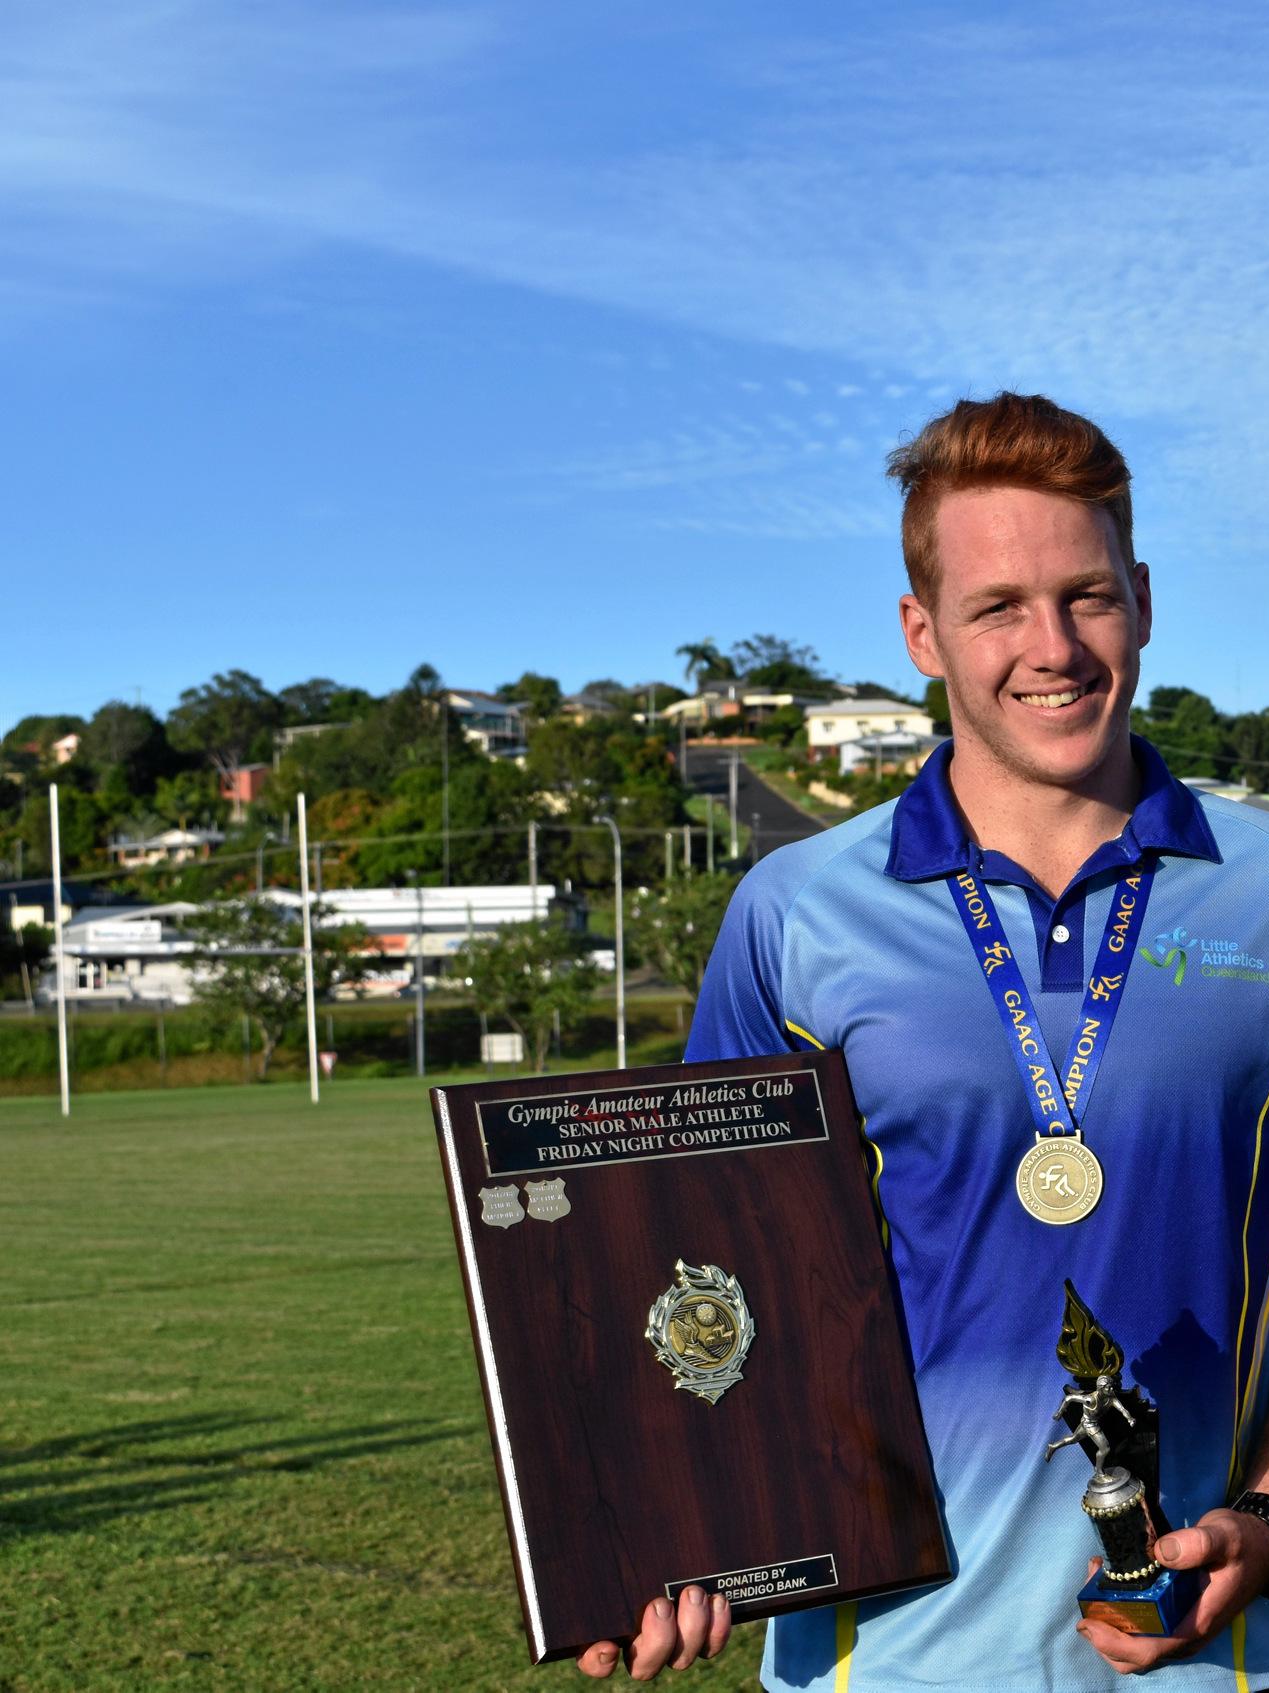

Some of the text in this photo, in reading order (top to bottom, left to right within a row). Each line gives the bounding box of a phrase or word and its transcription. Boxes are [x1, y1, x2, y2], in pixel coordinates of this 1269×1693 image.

[1108, 894, 1136, 952] GAAC
[1200, 939, 1239, 952] Little
[1200, 952, 1265, 969] Athletics
[1004, 989, 1039, 1057] GAAC
[1028, 1063, 1059, 1115] AGE
[508, 1077, 794, 1125] Gympie Amateur Athletics Club
[558, 1104, 765, 1139] SENIOR MALE ATHLETE
[537, 1121, 792, 1162] FRIDAY NIGHT COMPETITION
[1021, 1143, 1097, 1212] GYMPIE AMATEUR ATHLETICS CLUB
[717, 1567, 787, 1590] DONATED BY
[725, 1576, 808, 1601] BENDIGO BANK
